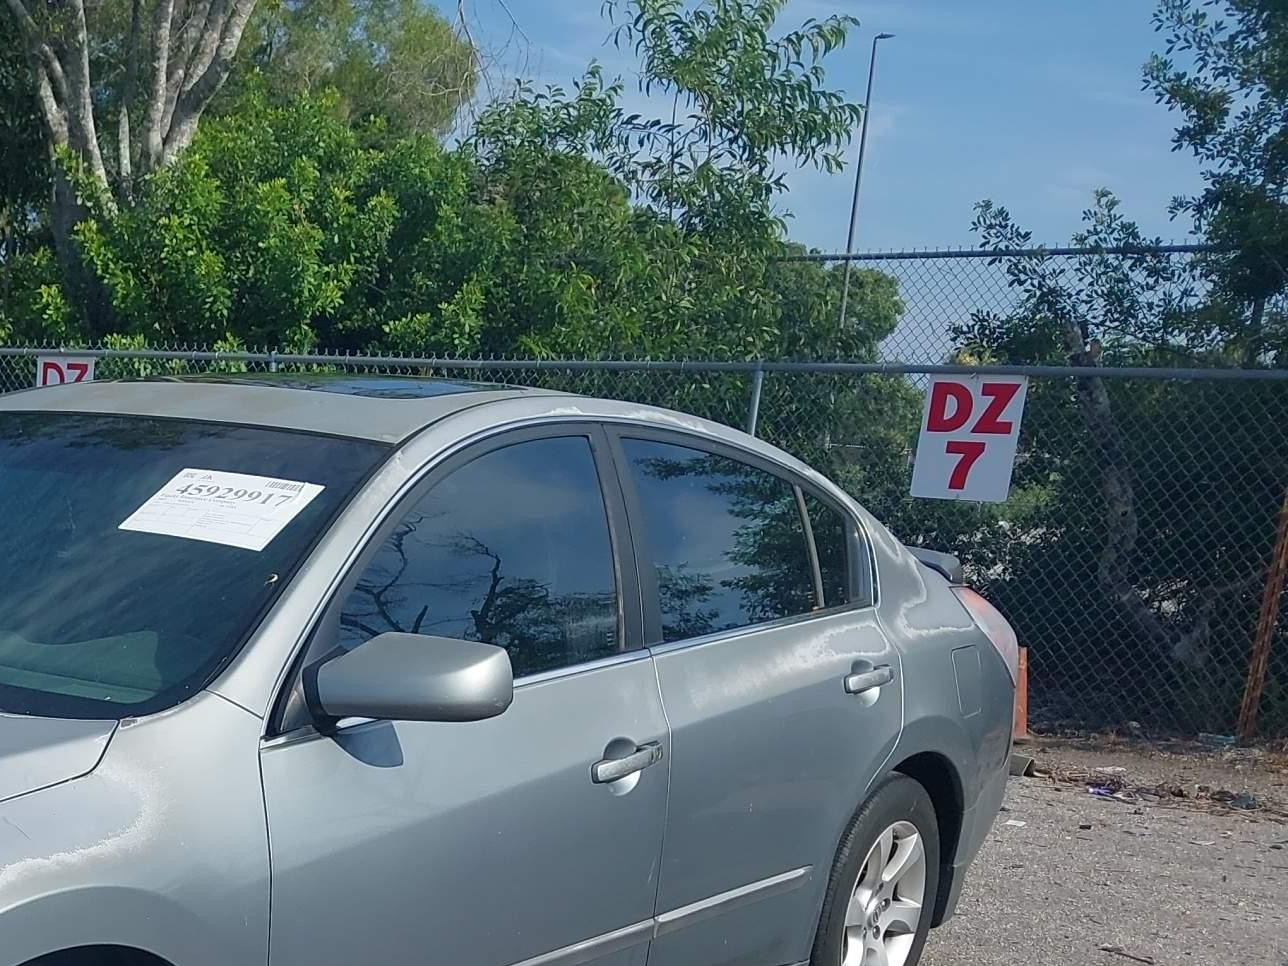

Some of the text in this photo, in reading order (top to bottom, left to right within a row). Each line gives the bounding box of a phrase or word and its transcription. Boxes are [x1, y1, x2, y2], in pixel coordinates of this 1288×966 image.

[926, 381, 1022, 435] DZ
[945, 440, 986, 490] 7
[175, 482, 293, 508] 45929917
